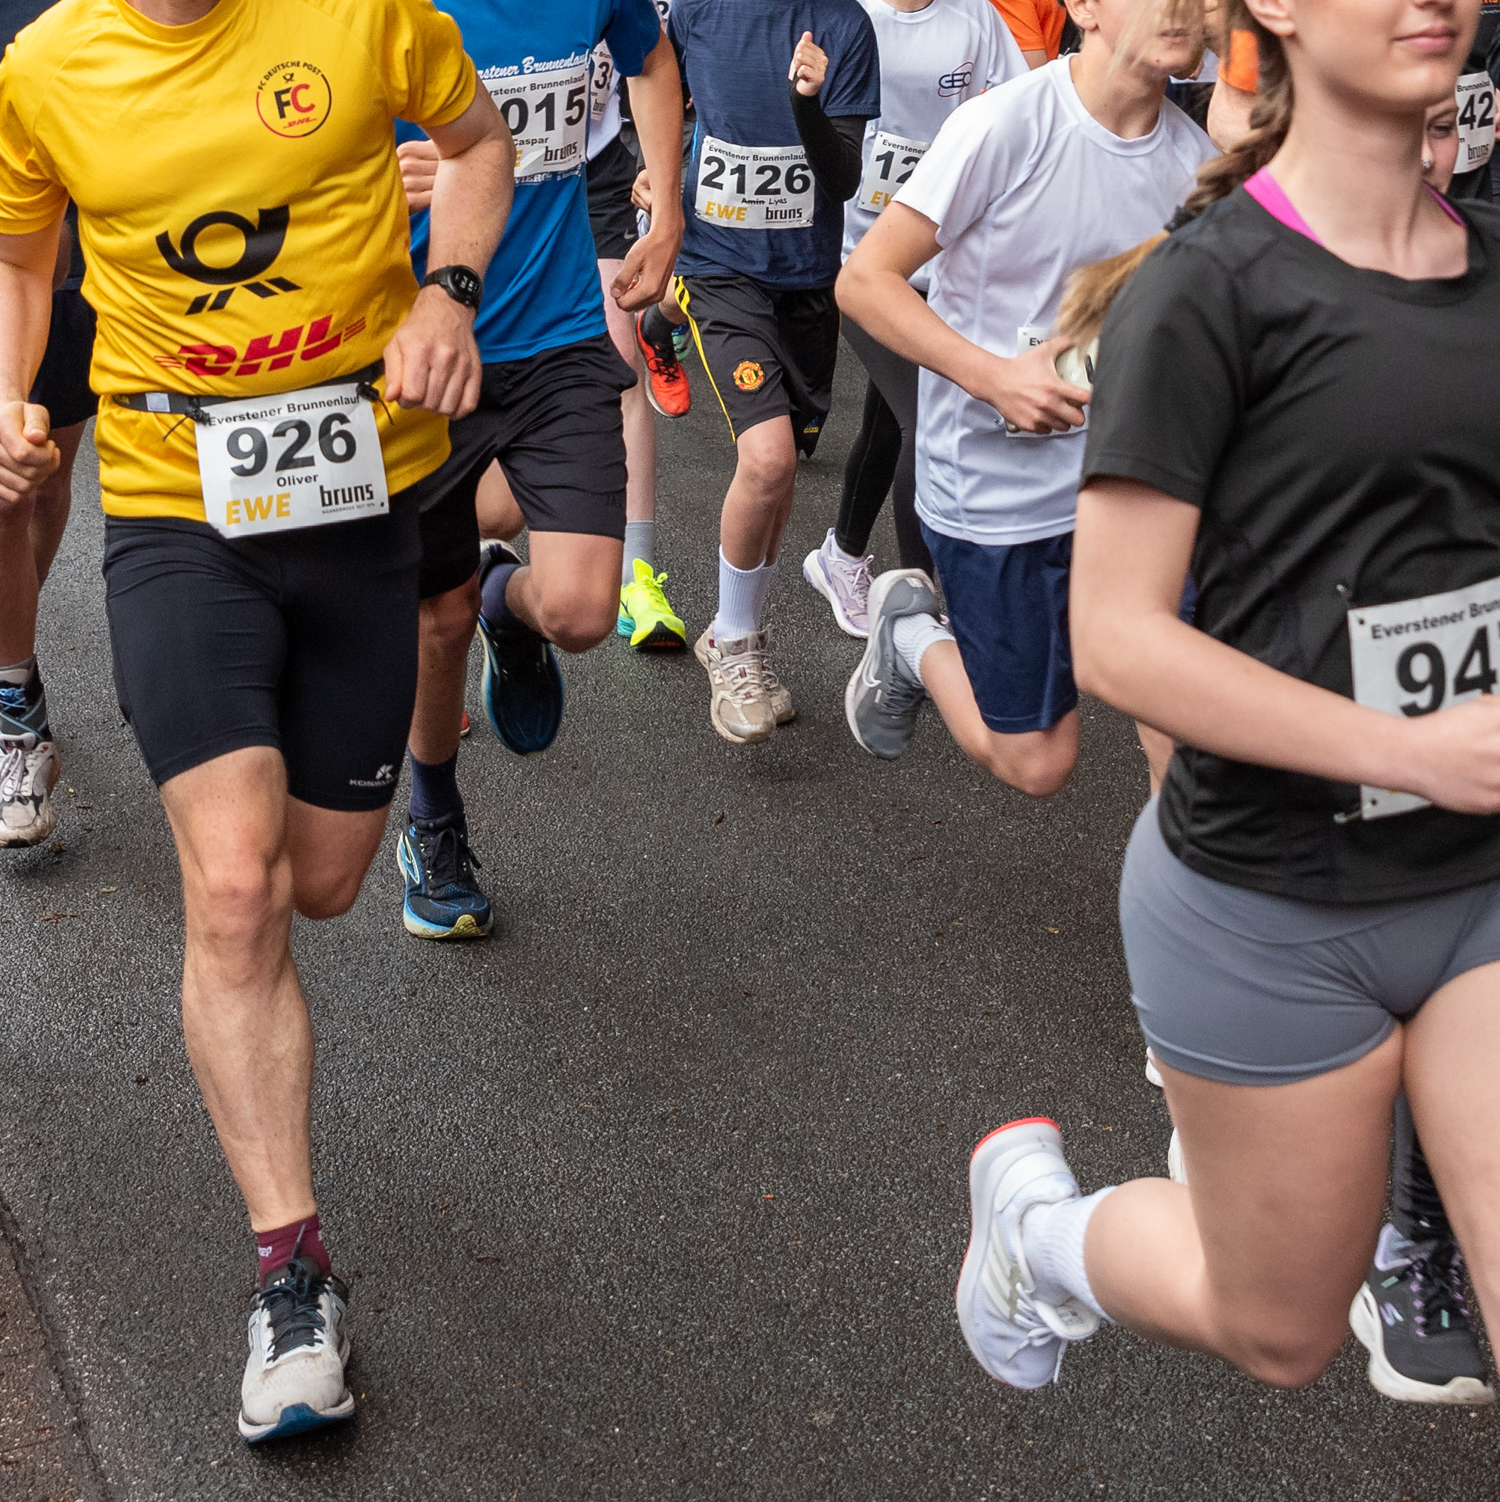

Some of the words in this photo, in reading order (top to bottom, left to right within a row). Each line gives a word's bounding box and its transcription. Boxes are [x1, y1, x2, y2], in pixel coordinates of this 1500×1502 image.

[263, 61, 300, 81] DEUTSCHE
[302, 62, 322, 75] POST
[489, 86, 527, 96] rstener
[530, 73, 585, 91] Brunnenlauf
[274, 83, 316, 119] FC
[500, 85, 586, 136] 015
[1459, 90, 1494, 130] 42
[512, 136, 549, 147] Caspar
[544, 142, 578, 162] bruns
[708, 145, 750, 161] Everstener
[752, 153, 807, 162] Brunnenlauf
[700, 155, 811, 195] 2126
[875, 150, 921, 185] 12
[704, 201, 747, 221] EWE
[765, 207, 803, 220] bruns
[177, 314, 342, 377] DHL
[208, 406, 283, 427] Everstener
[286, 394, 361, 413] Brunnenlauf
[226, 412, 357, 477] 926
[277, 474, 319, 488] Oliver
[226, 493, 291, 526] EWE
[320, 484, 374, 507] bruns
[1371, 609, 1464, 640] Everstener
